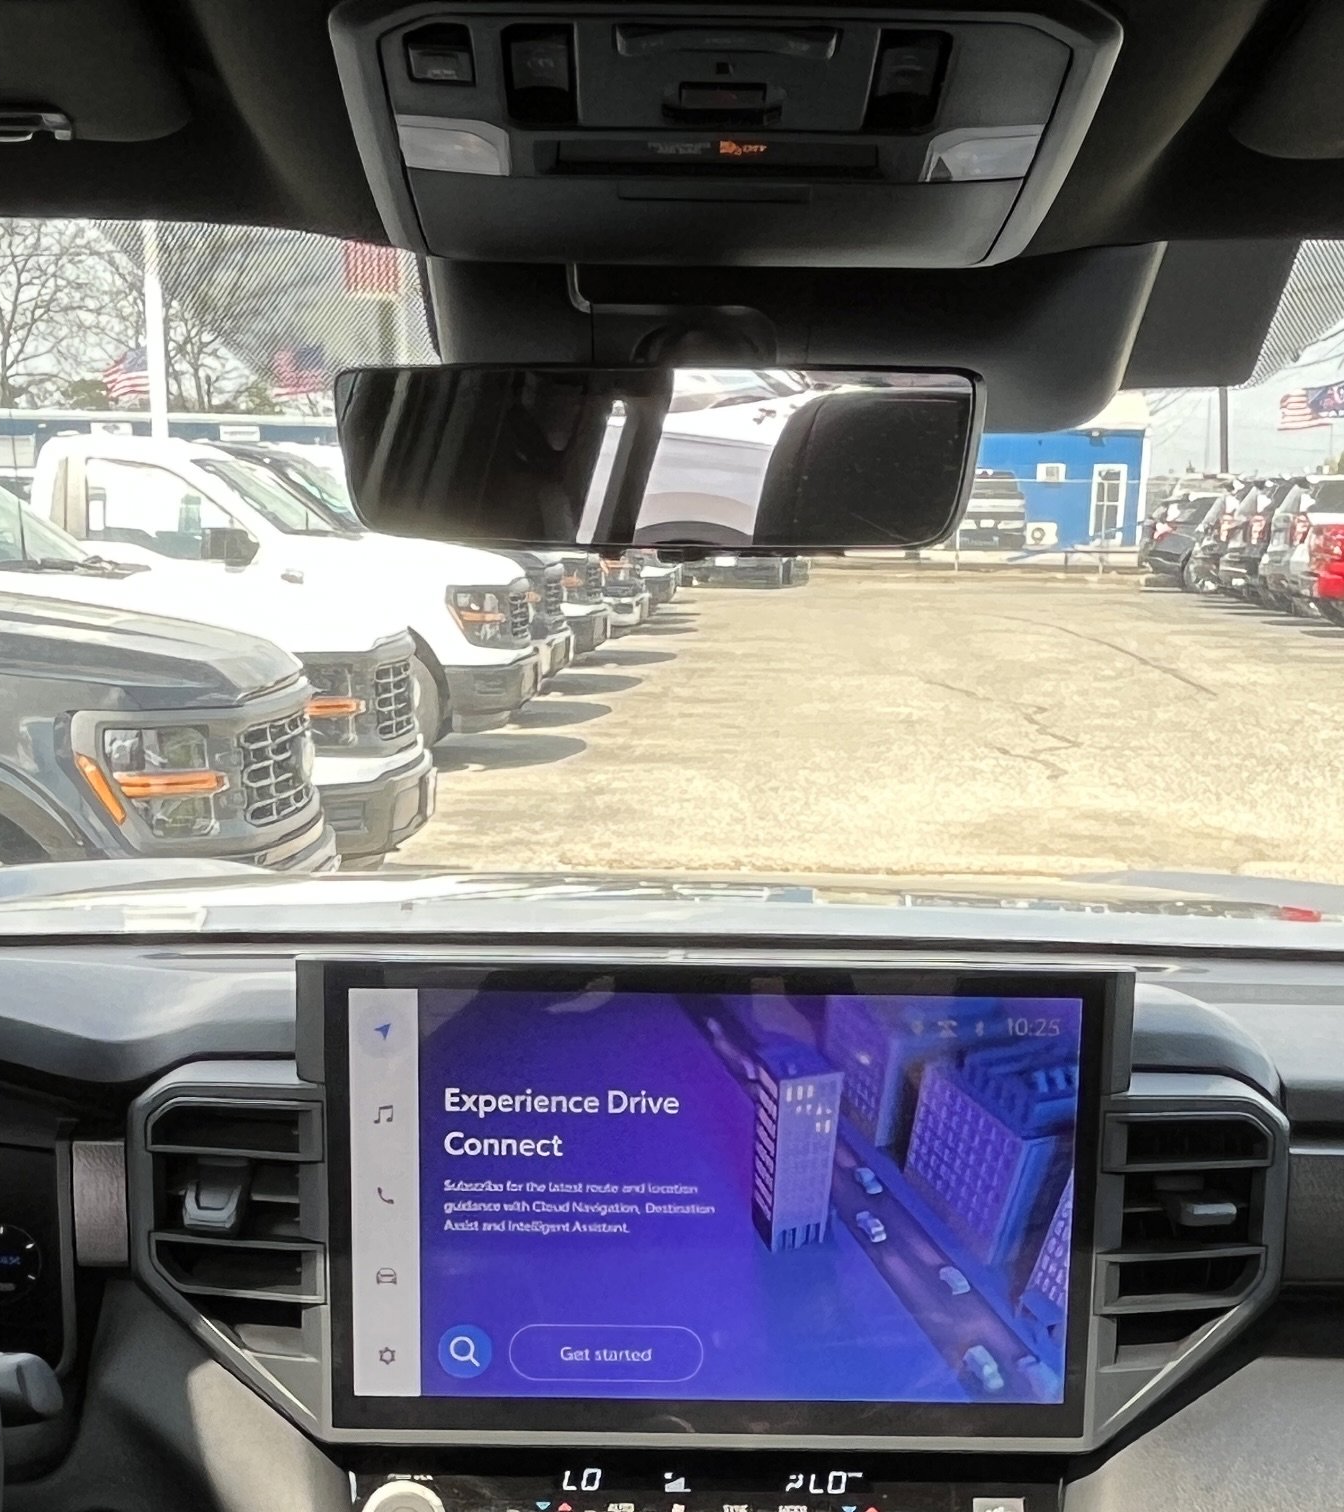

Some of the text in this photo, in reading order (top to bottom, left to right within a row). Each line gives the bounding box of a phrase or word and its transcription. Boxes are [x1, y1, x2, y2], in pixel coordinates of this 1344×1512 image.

[1007, 1018, 1061, 1037] 10:25
[444, 1087, 680, 1118] Experience Drive
[444, 1132, 564, 1157] Connect
[506, 1180, 524, 1192] for
[526, 1181, 546, 1193] the
[549, 1182, 583, 1193] latest
[586, 1183, 619, 1194] route
[621, 1183, 645, 1194] and
[648, 1183, 699, 1194] location
[503, 1201, 530, 1213] with
[532, 1202, 570, 1213] Cloud
[572, 1202, 642, 1216] Navigation,
[645, 1203, 716, 1215] Destination
[482, 1220, 506, 1232] and
[560, 1346, 653, 1362] Get started
[562, 1468, 602, 1491] LO
[809, 1471, 847, 1494] LO
